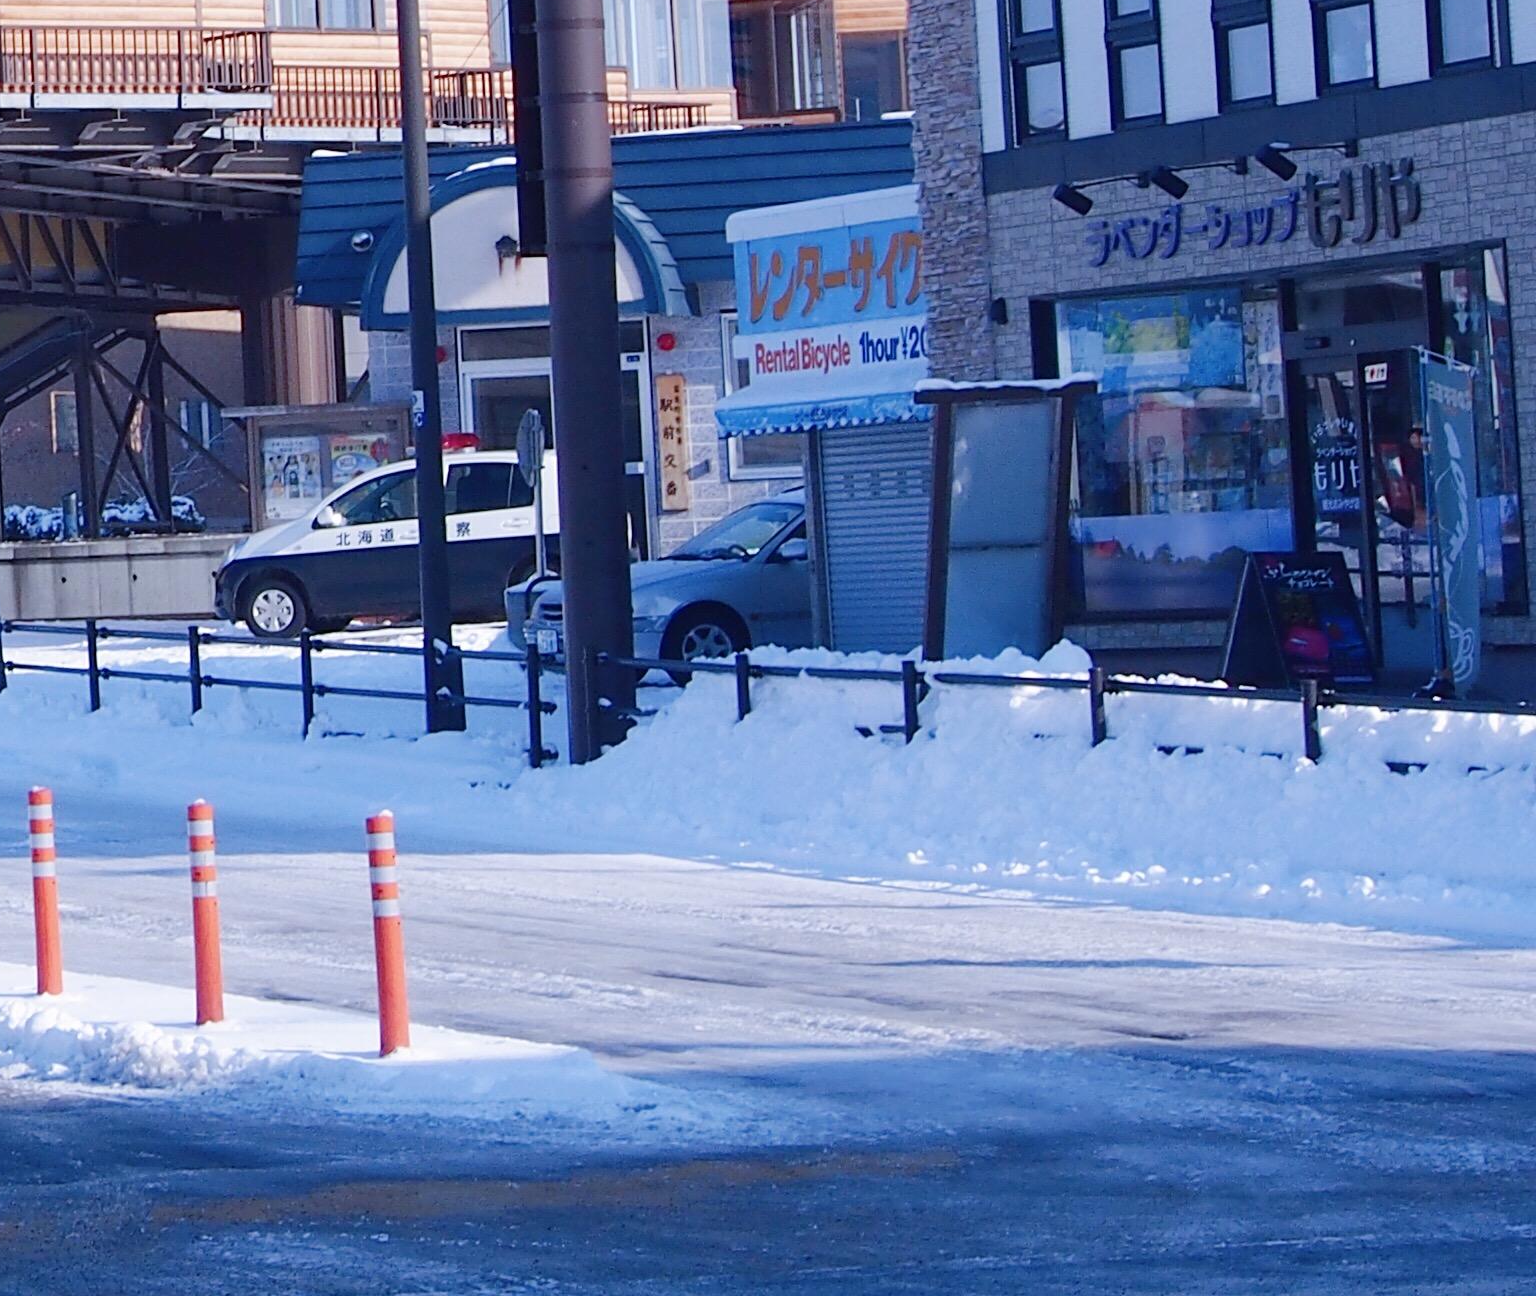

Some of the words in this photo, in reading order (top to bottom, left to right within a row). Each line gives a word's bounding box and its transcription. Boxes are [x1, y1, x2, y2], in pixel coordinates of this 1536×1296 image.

[1085, 190, 1301, 268] ラベンダーショップ
[1305, 157, 1422, 248] もりや
[755, 340, 800, 375] Rental
[802, 334, 851, 374] Bicycle
[859, 331, 899, 364] 1hour
